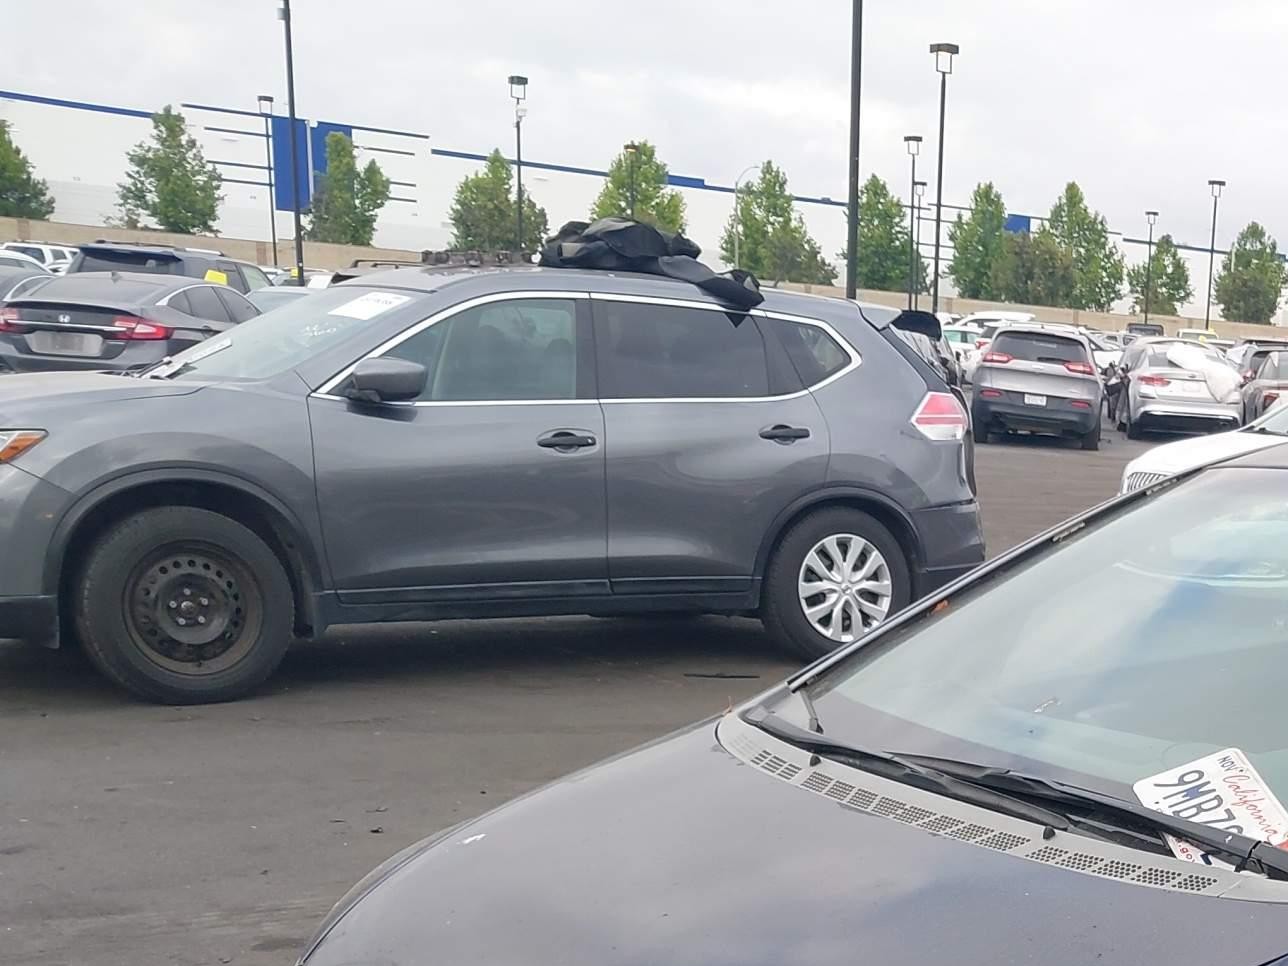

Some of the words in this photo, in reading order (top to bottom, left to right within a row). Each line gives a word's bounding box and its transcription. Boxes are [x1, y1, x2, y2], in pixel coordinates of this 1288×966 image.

[1217, 755, 1240, 772] NOV
[1153, 769, 1244, 835] 9MB7
[1222, 774, 1281, 842] California
